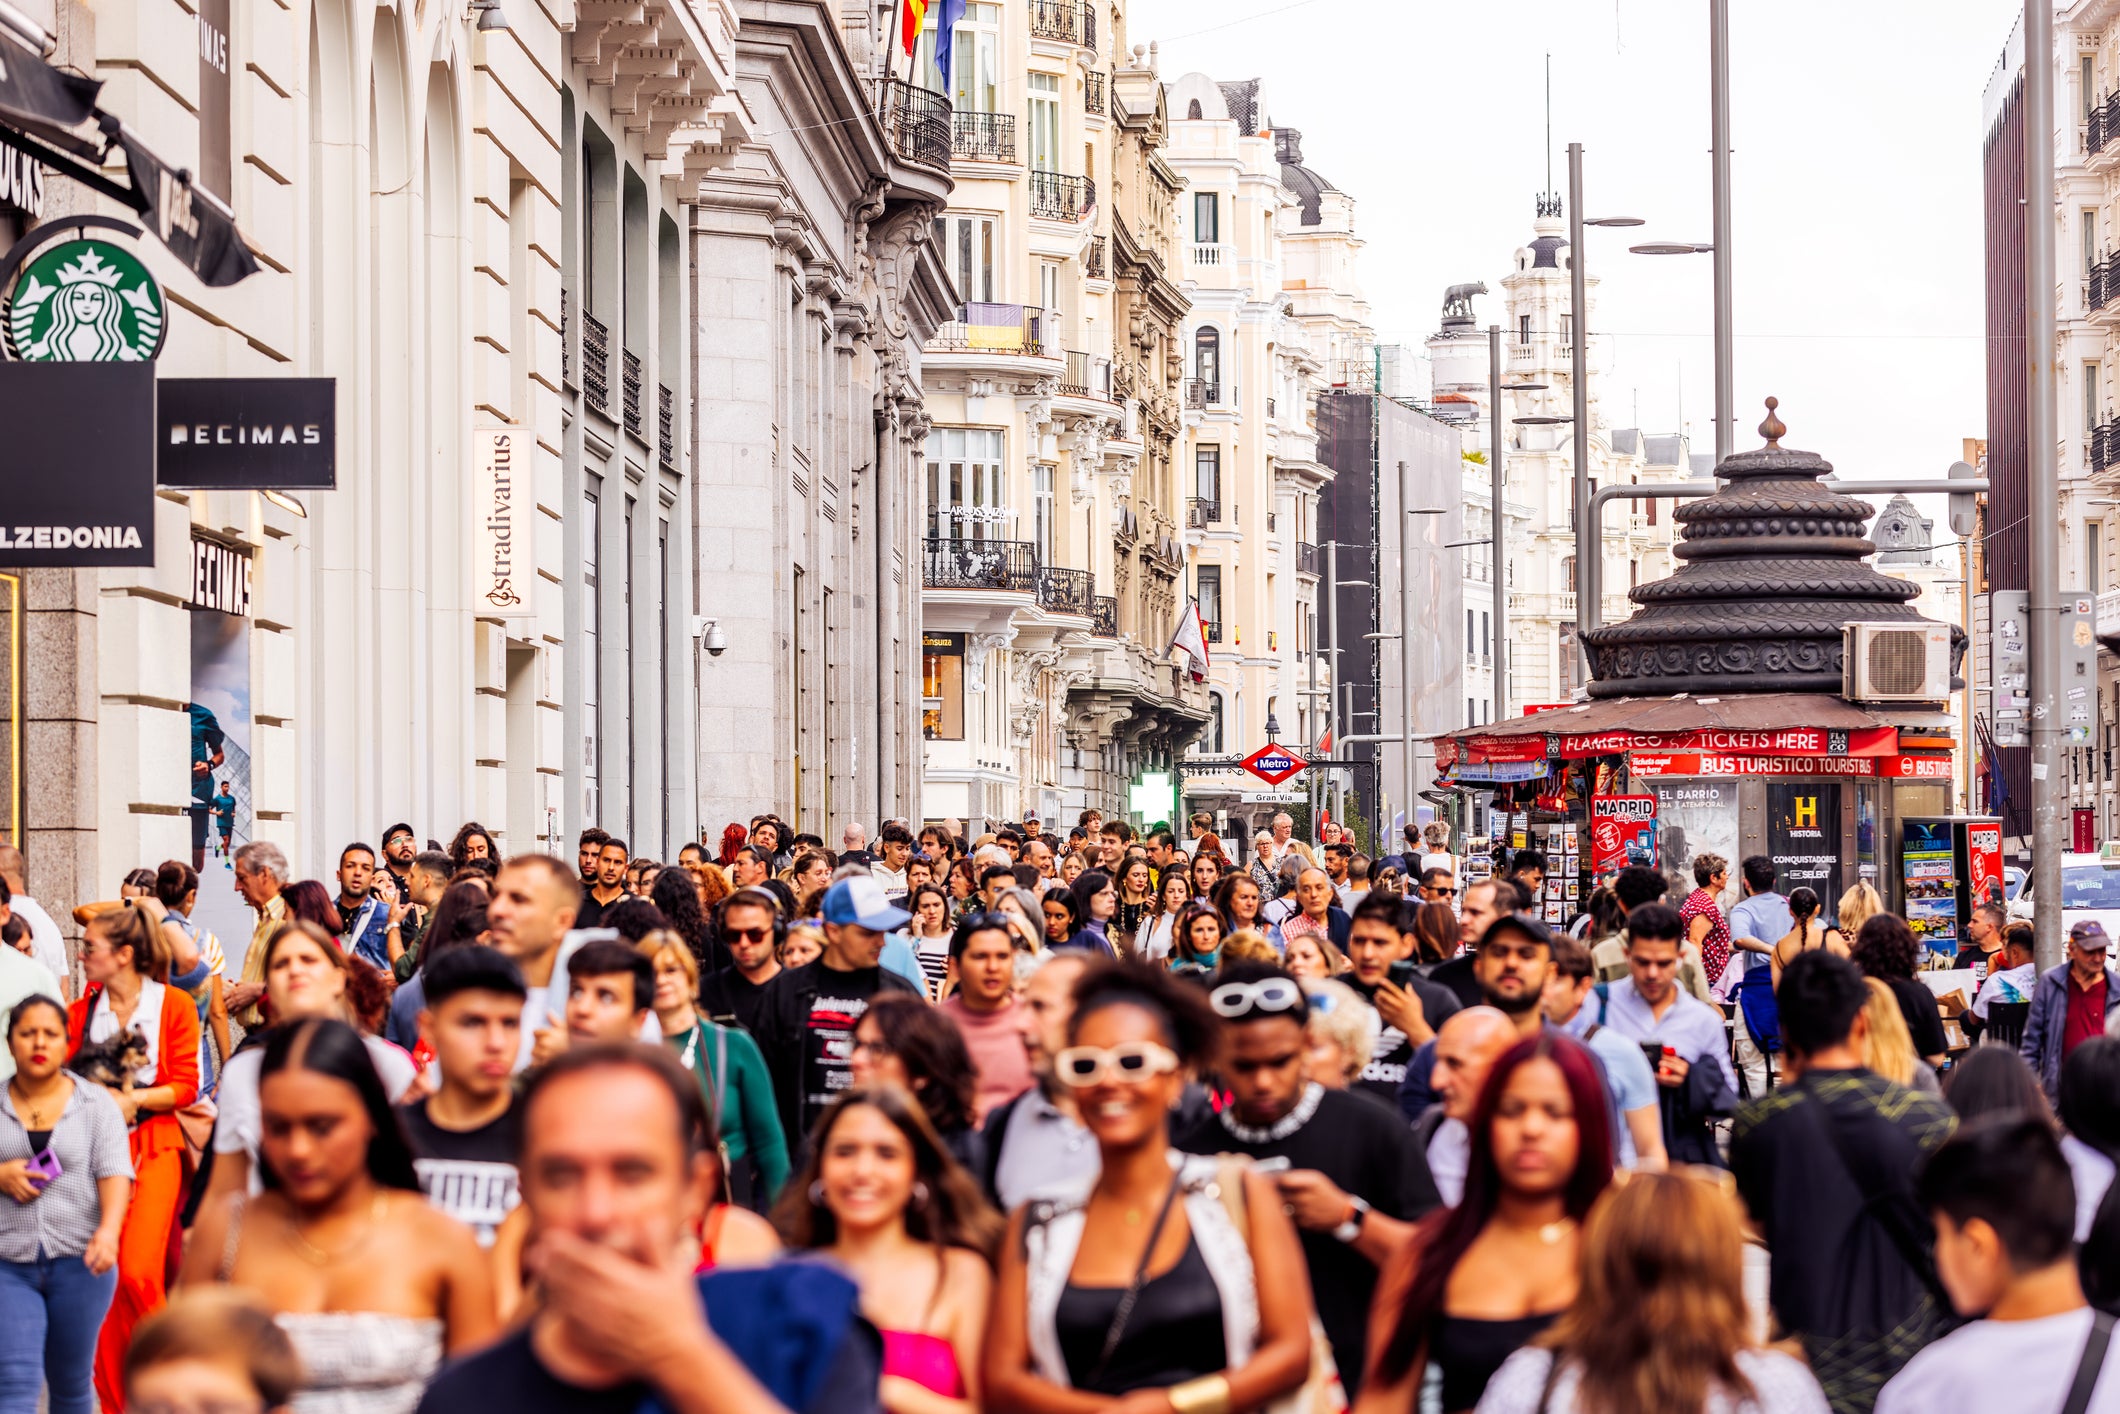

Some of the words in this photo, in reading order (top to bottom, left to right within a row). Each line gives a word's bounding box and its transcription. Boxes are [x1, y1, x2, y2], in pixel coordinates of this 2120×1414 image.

[486, 433, 513, 591] stradivarius
[0, 526, 142, 549] LZEDONIA
[189, 538, 253, 616] ECIMAS
[1565, 735, 1662, 752] FLAMENCO
[1699, 732, 1770, 748] TICKETS
[1775, 733, 1819, 750] HERE
[1259, 758, 1289, 769] Metro
[1702, 757, 1736, 773] BUS
[1818, 757, 1860, 774] TOURIST
[1859, 759, 1872, 774] BUS
[1916, 760, 1935, 776] BUS
[1659, 790, 1673, 800] EL
[1676, 789, 1720, 800] BARRIO
[1595, 800, 1653, 816] MADRID
[1681, 801, 1726, 809] ATEMPORAL
[1794, 796, 1818, 827] H
[1789, 830, 1823, 838] HISTORIA
[1772, 855, 1837, 865] CONQUISTADORES
[1357, 1059, 1408, 1083] das
